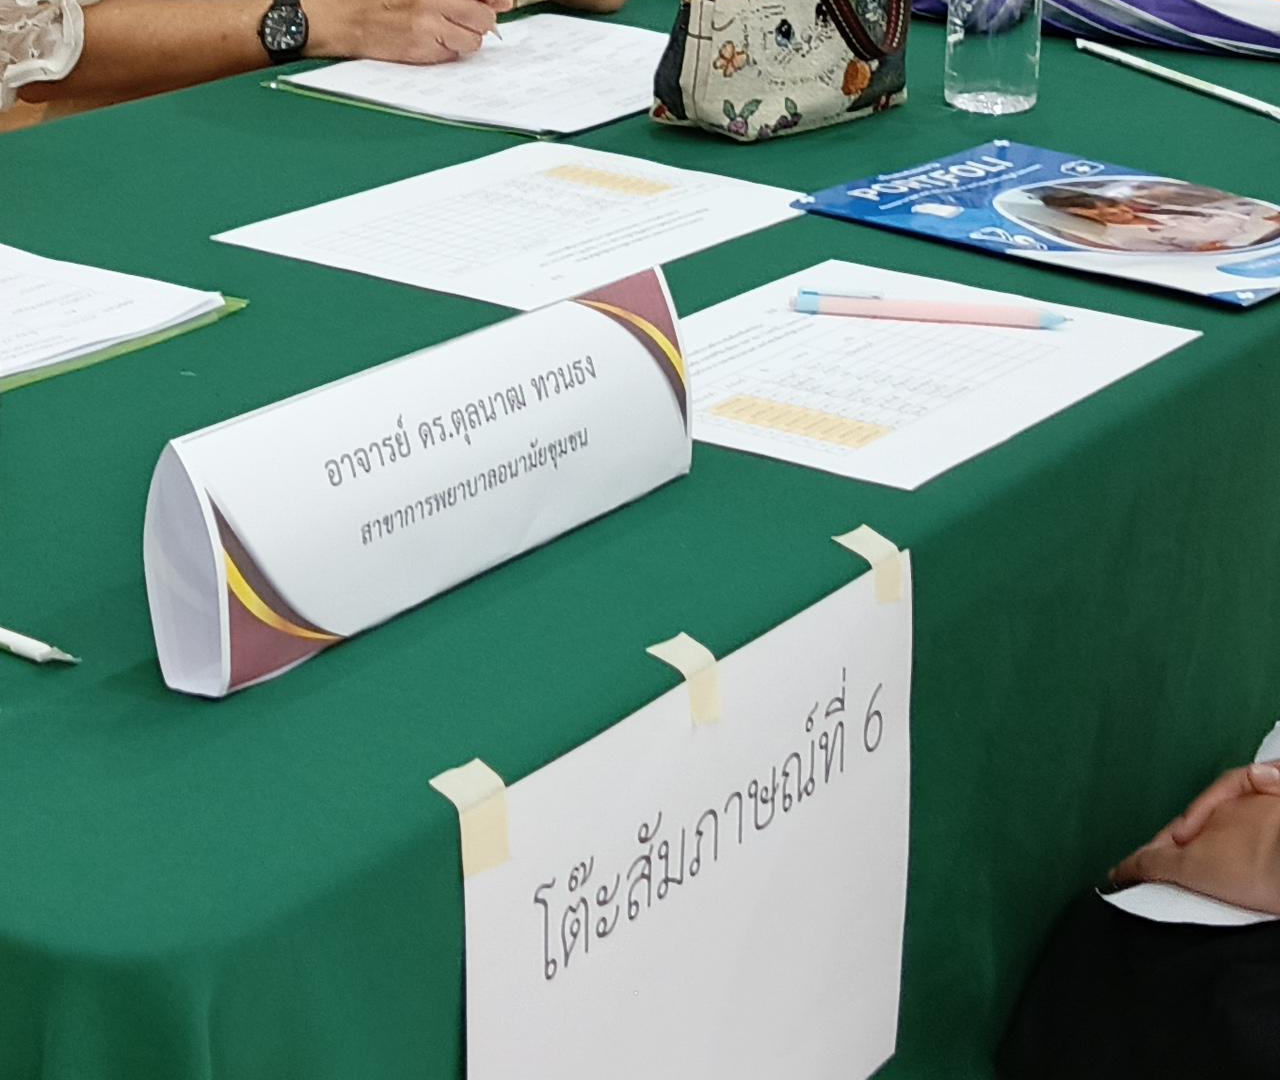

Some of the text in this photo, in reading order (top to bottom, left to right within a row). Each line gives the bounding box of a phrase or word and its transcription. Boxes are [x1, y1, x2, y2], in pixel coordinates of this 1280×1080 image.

[323, 413, 412, 487] อาจารย์
[530, 354, 598, 402] ทวนธง
[360, 426, 590, 546] สาขาการพยาบาลอนามัยชุมชน
[532, 666, 884, 981] โต๊ะสัมภาษณ์ที่ 6
